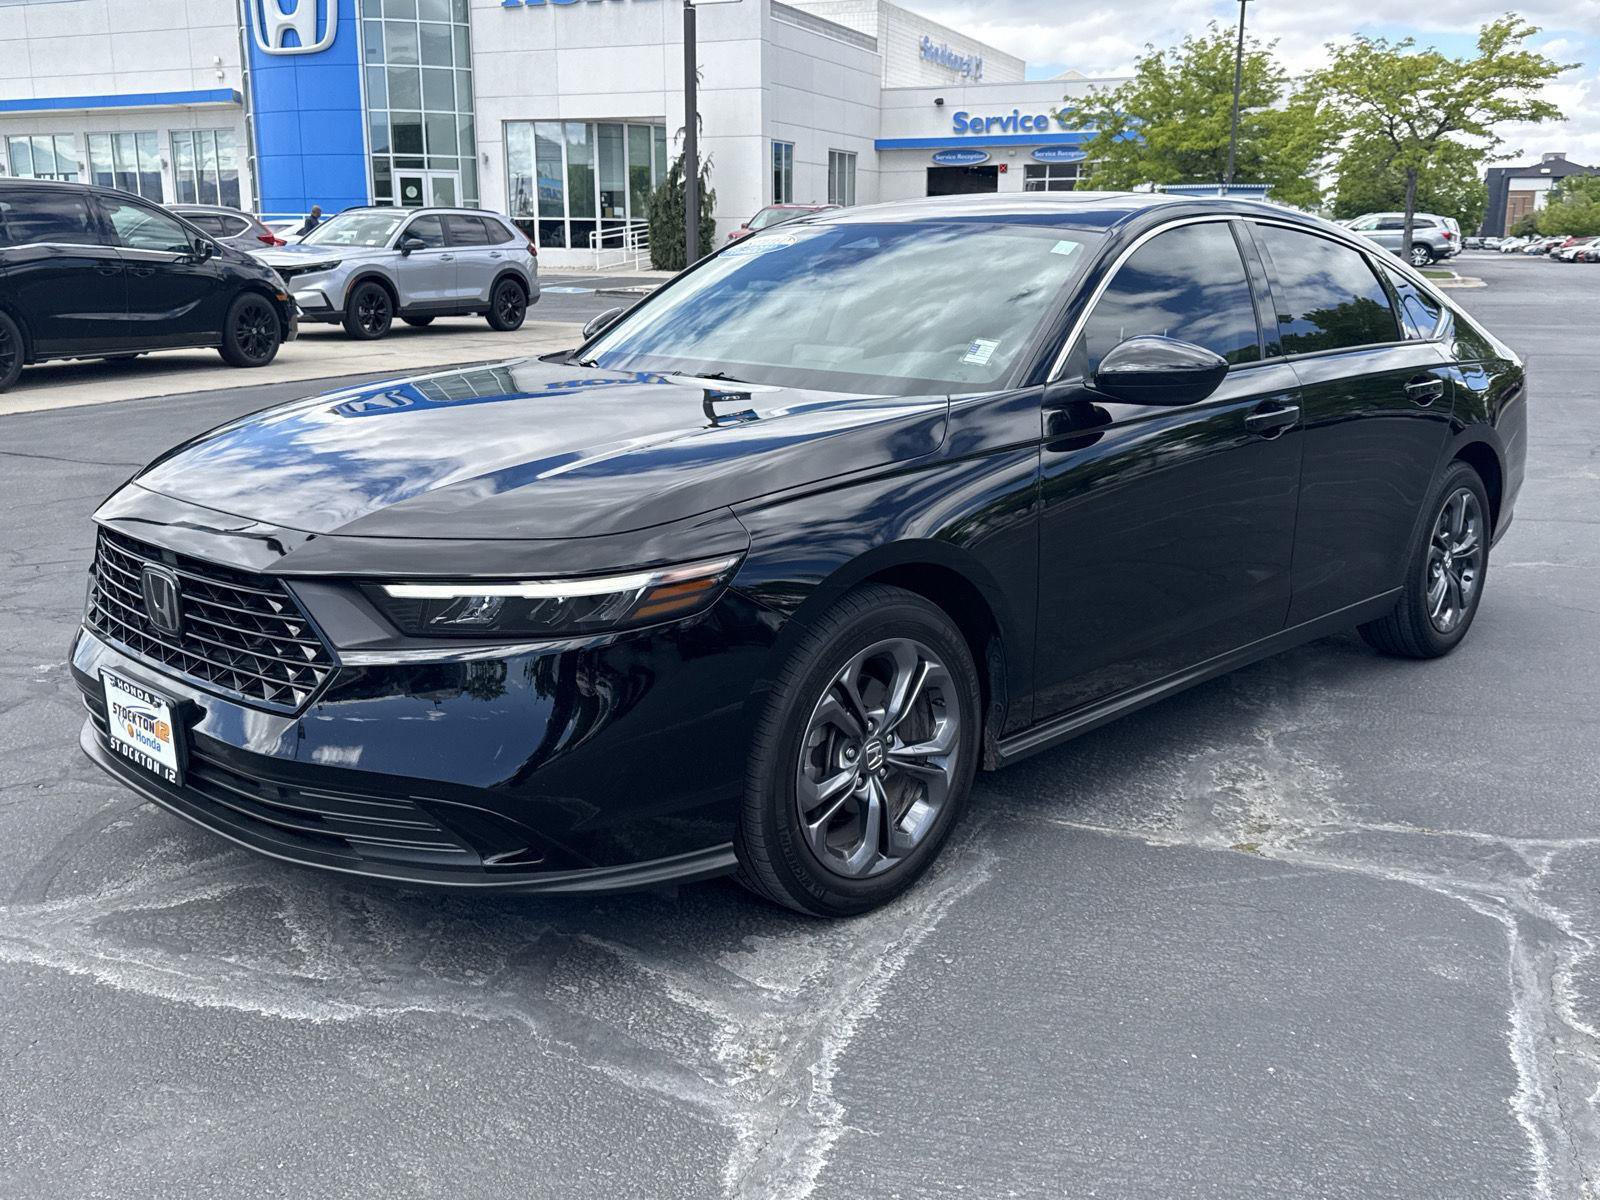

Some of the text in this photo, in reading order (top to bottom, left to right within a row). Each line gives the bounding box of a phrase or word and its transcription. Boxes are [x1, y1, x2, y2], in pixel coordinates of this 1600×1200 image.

[952, 109, 1049, 134] Service
[935, 153, 956, 161] Service
[117, 679, 151, 704] HONDA
[112, 702, 155, 734] STOCKTON
[135, 728, 161, 752] Honda
[110, 737, 176, 784] STOCKTON 12
